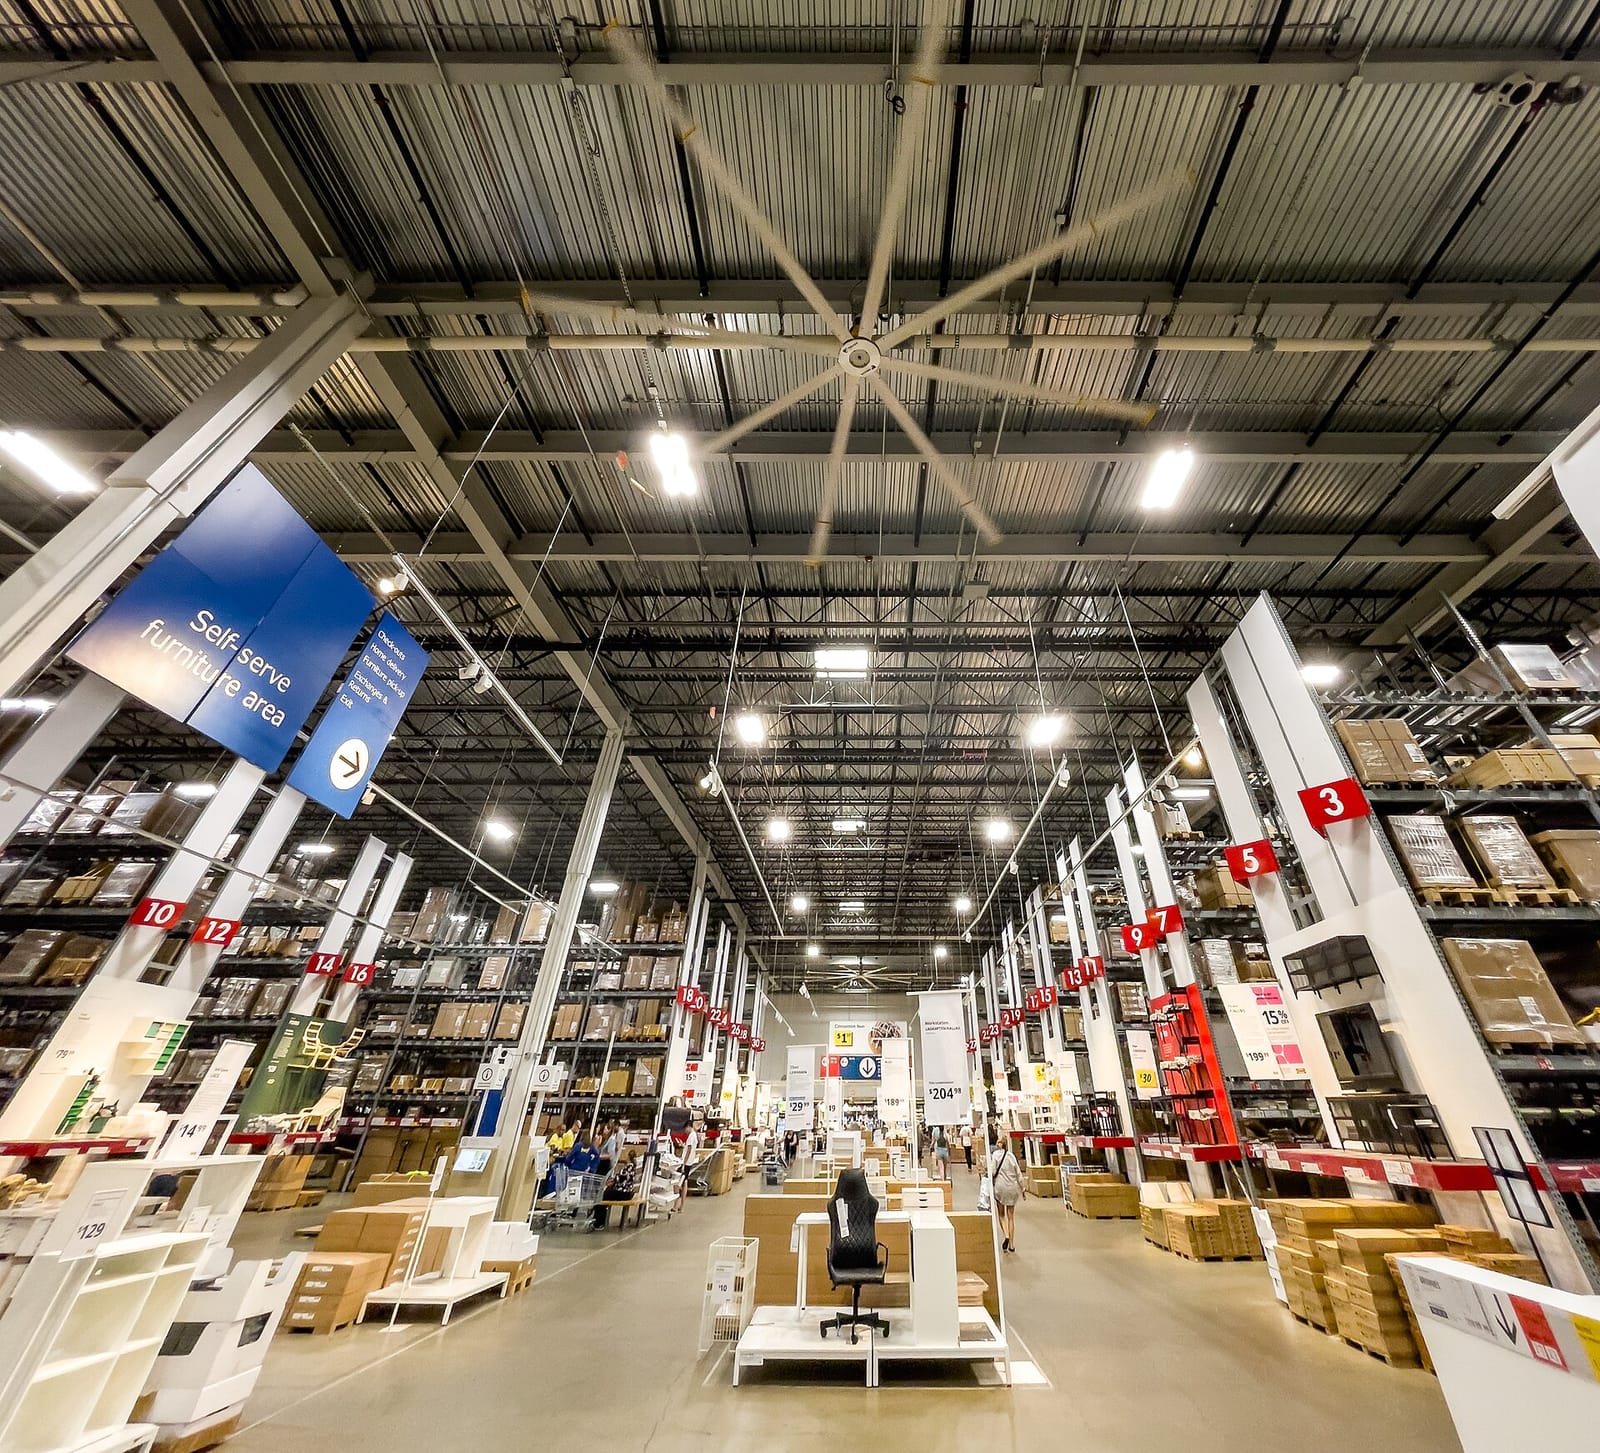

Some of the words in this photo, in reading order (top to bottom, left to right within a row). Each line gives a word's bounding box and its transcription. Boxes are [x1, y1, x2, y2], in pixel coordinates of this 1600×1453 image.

[190, 609, 292, 694] Self-serve
[377, 630, 407, 662] Check-outs
[370, 642, 387, 662] Home
[386, 658, 407, 681] delivery
[140, 618, 242, 698] furniture
[242, 690, 286, 728] area
[362, 655, 389, 682] Furniture
[386, 678, 406, 699] pick-up
[347, 679, 372, 703] Returns
[353, 670, 384, 700] Exchanges
[382, 695, 389, 705] &
[340, 693, 354, 709] Exit
[1319, 787, 1344, 817] 3
[1242, 848, 1260, 873] 5
[143, 901, 176, 925] 10
[1155, 911, 1168, 932] 7
[203, 920, 232, 942] 12
[1131, 927, 1143, 947] 9
[315, 955, 335, 973] 14
[1083, 958, 1098, 976] 11
[350, 965, 368, 983] 16
[1067, 969, 1083, 986] 13
[682, 988, 694, 1002] 18
[1039, 988, 1052, 1003] 15
[710, 1009, 721, 1021] 22
[1010, 1009, 1021, 1021] 19
[731, 1024, 741, 1036] 26
[989, 1024, 999, 1036] 23
[751, 1038, 760, 1048] 30
[76, 1222, 106, 1240] $129
